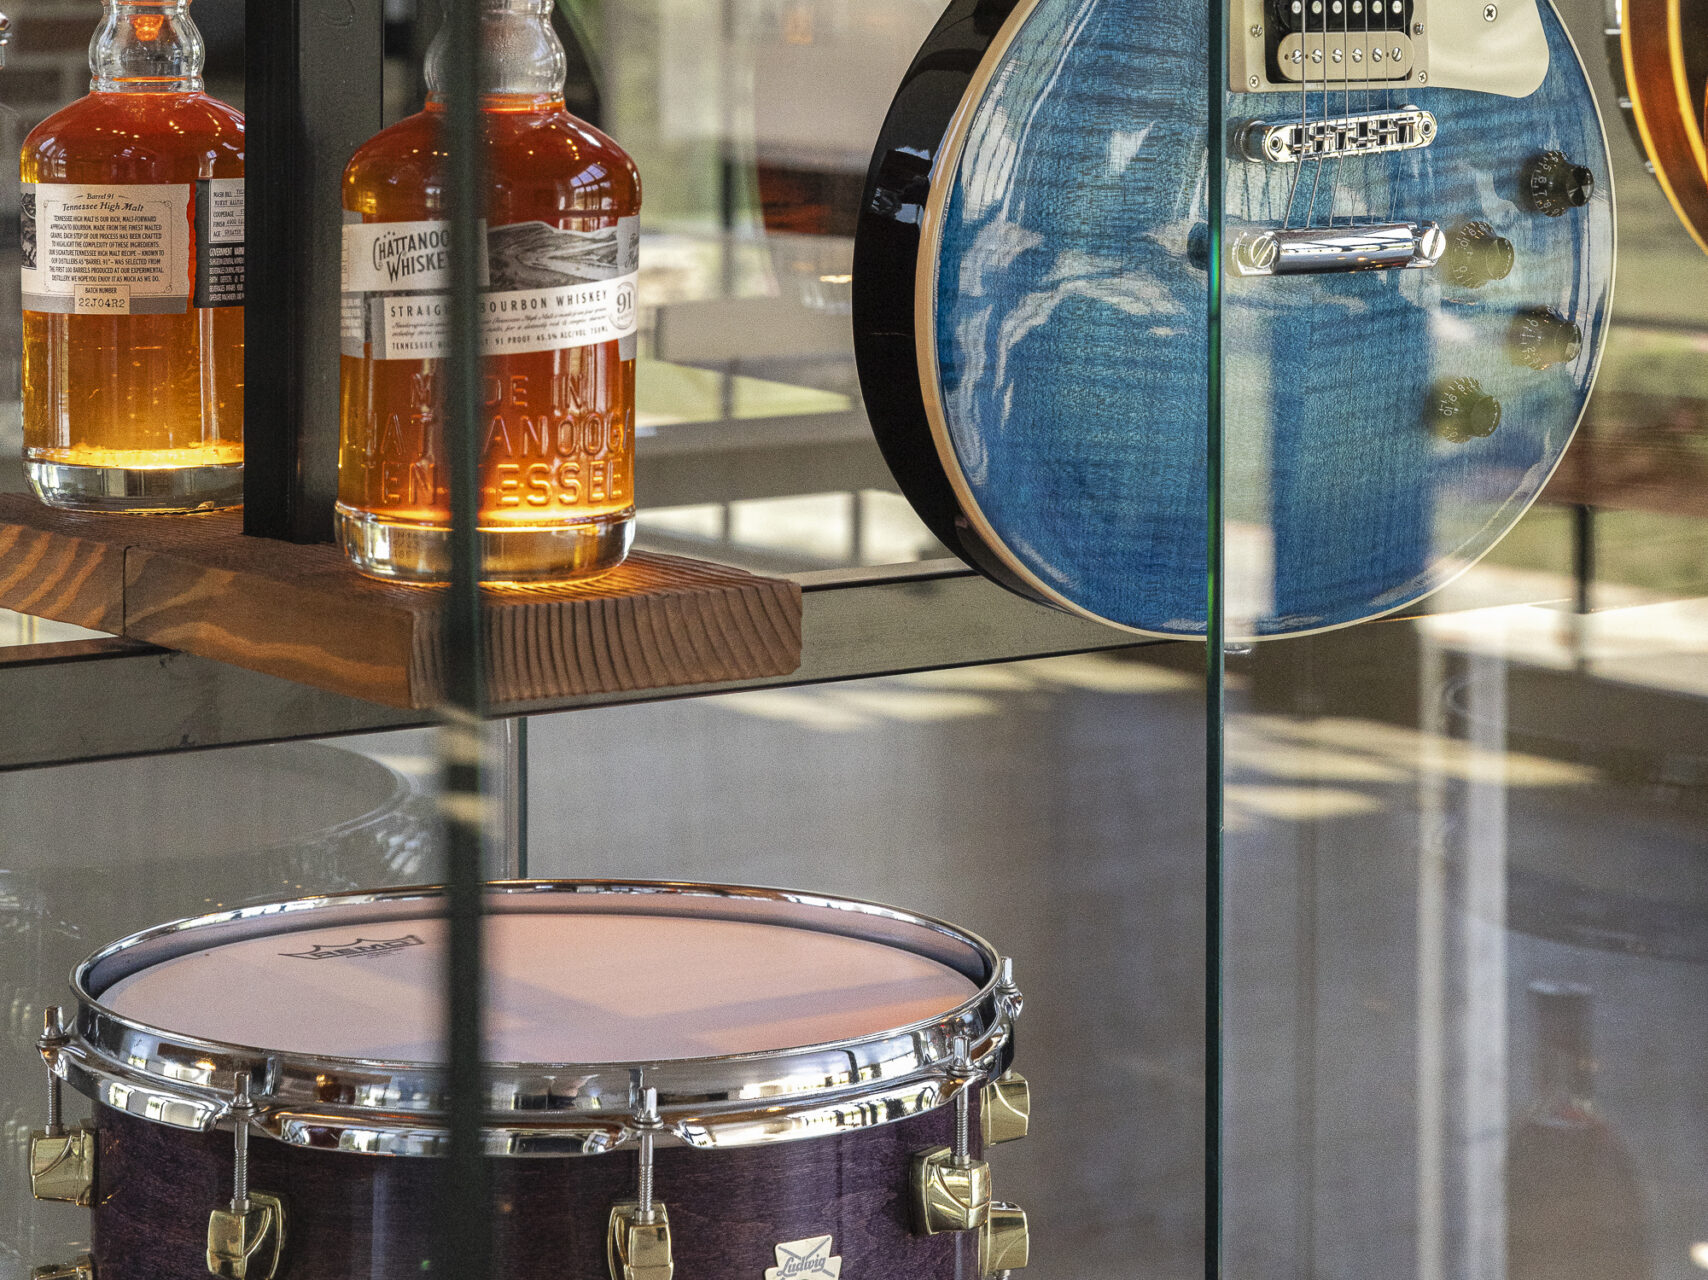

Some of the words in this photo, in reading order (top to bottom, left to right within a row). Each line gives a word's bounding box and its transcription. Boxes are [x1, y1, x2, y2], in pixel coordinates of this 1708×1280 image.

[62, 203, 98, 212] Tennessee
[99, 201, 120, 212] High
[121, 202, 144, 212] Malt
[373, 229, 450, 271] CHATTANOO
[387, 250, 447, 282] WHISKE
[390, 304, 449, 318] STRAIG
[556, 289, 607, 307] WHISKEY
[616, 291, 632, 313] 91
[776, 1253, 827, 1278] Ludwig
